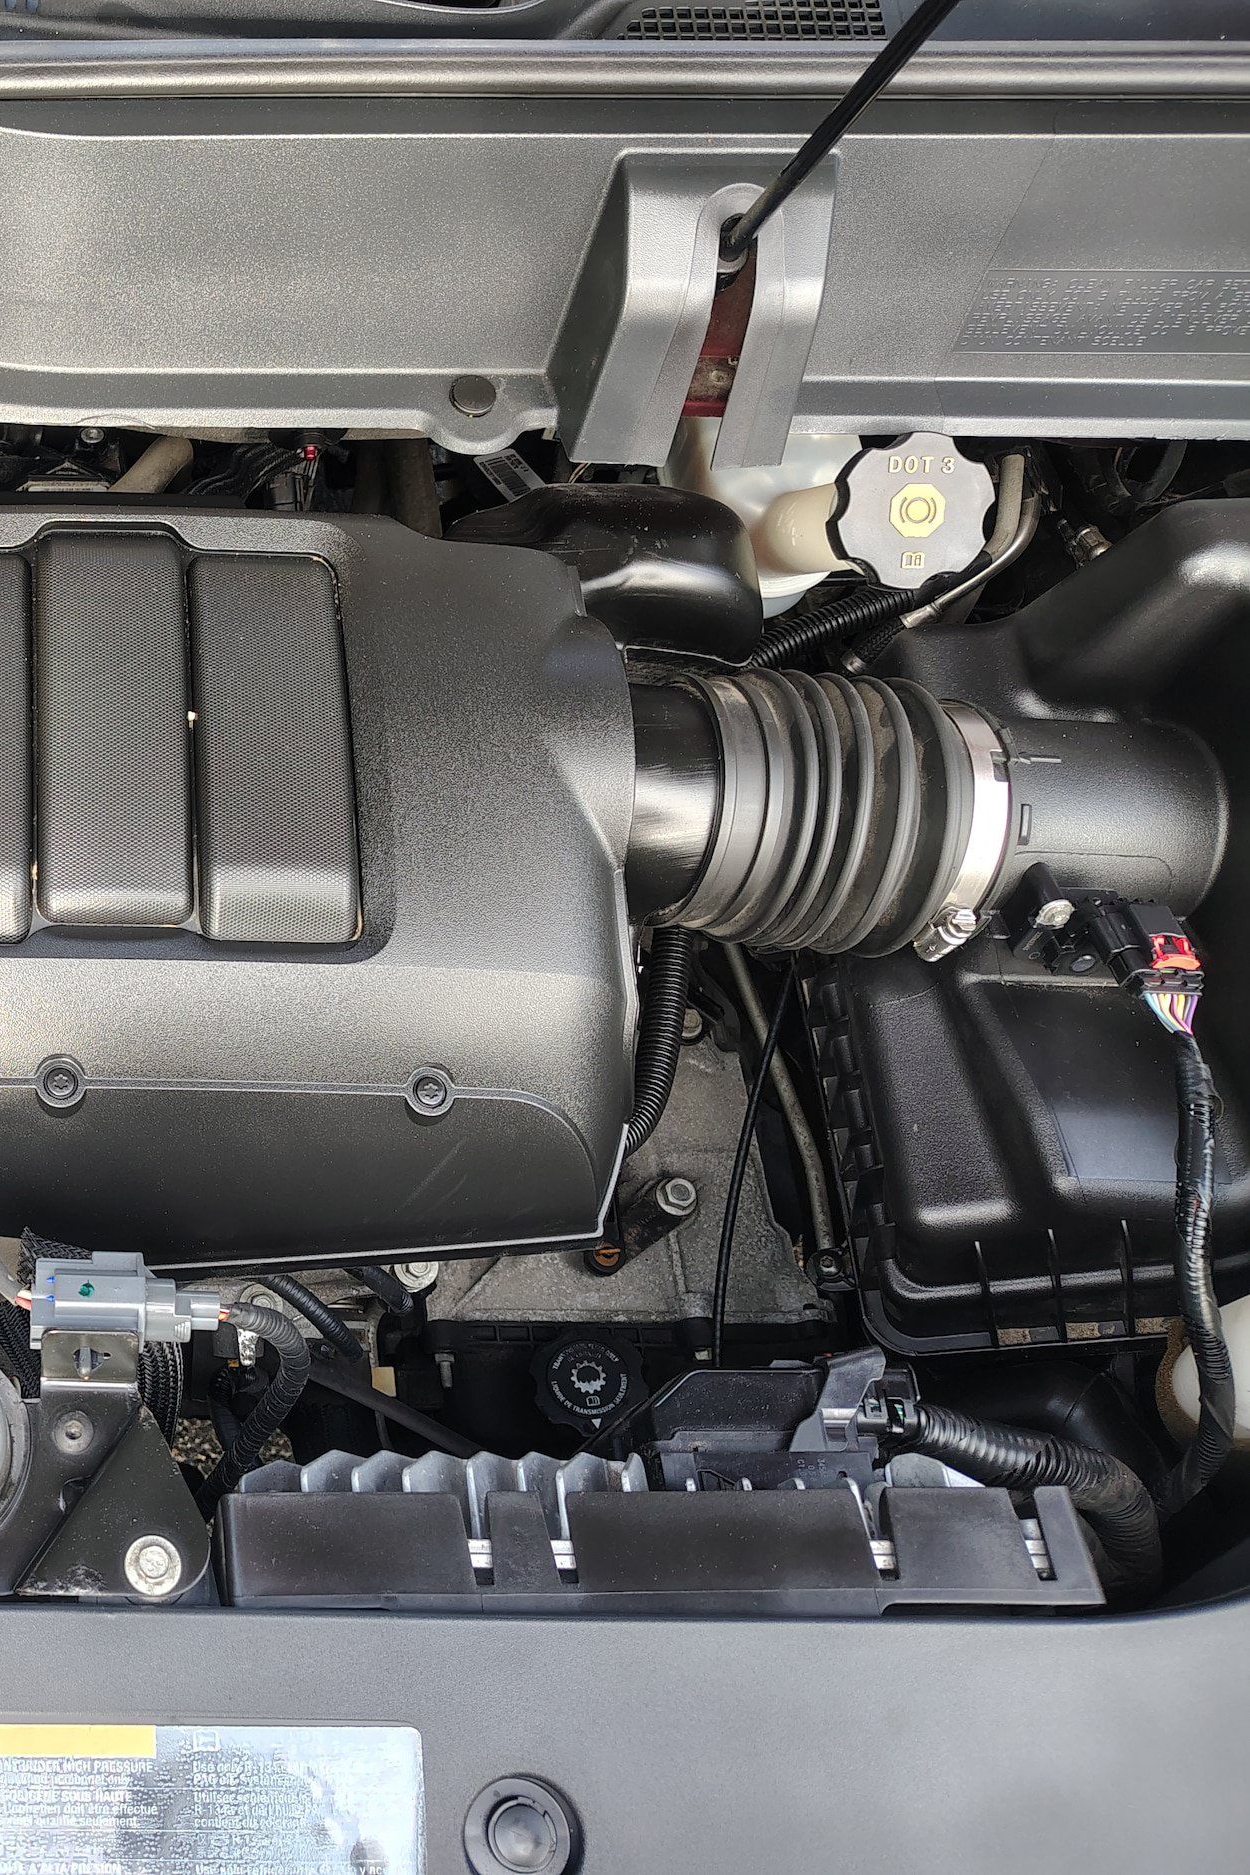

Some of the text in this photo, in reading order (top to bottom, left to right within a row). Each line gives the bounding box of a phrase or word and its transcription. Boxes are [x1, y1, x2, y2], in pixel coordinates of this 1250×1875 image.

[888, 456, 956, 475] DOT 3
[93, 1760, 154, 1774] PRESSURE
